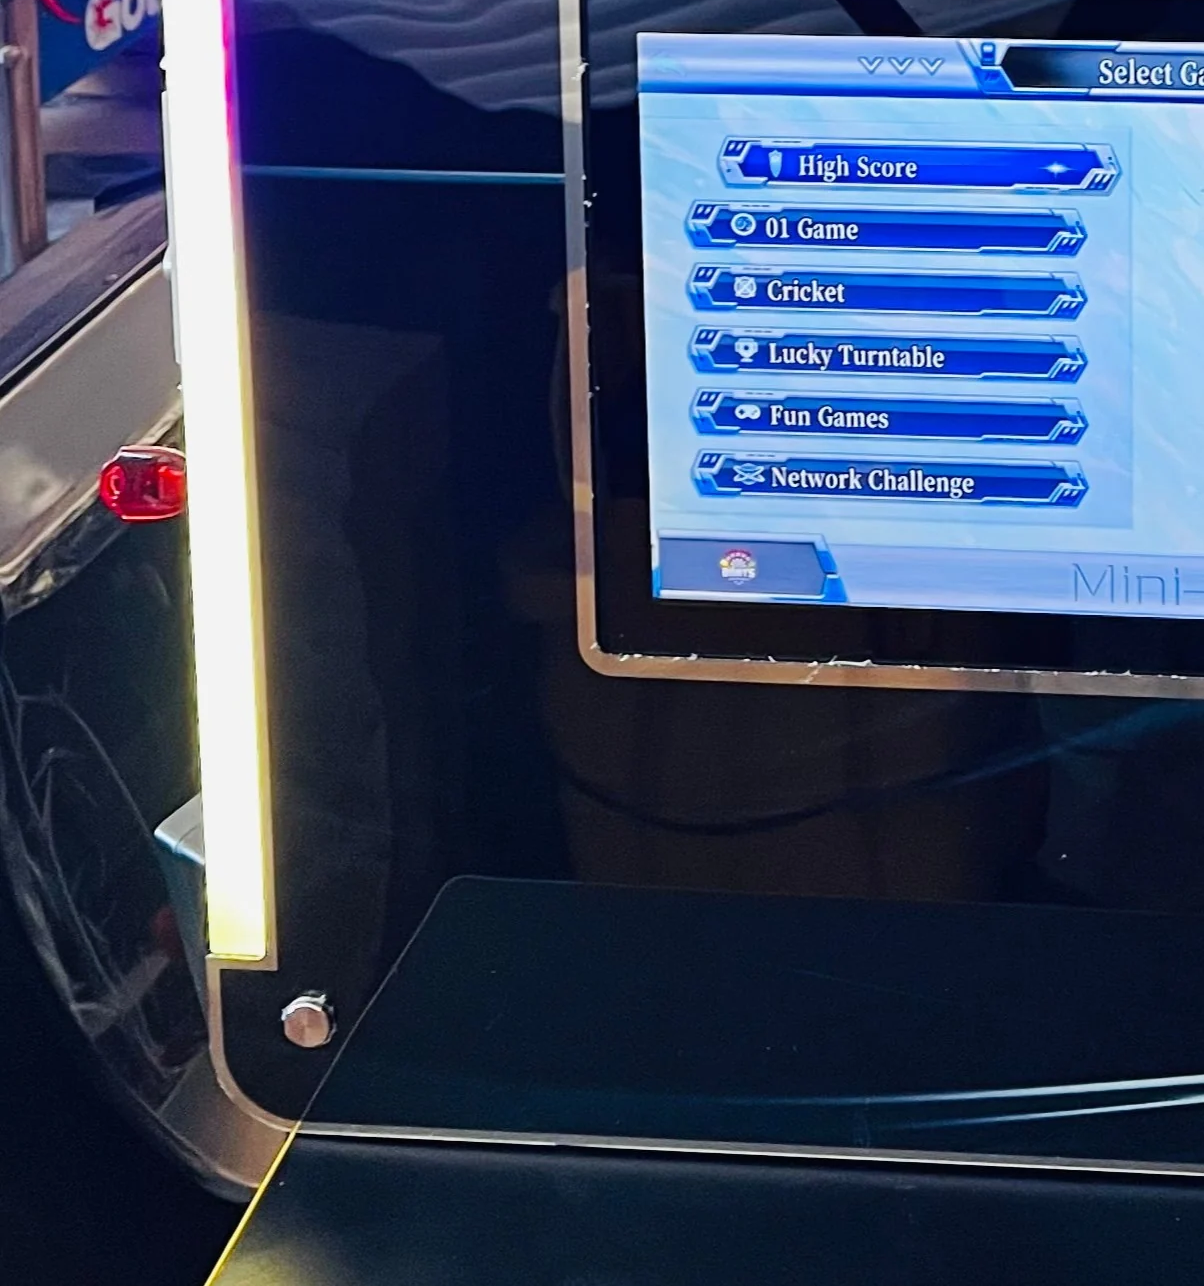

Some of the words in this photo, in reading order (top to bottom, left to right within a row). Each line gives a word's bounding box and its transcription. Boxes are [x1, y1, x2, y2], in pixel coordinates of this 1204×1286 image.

[1099, 59, 1172, 86] Select
[798, 154, 850, 183] High
[857, 156, 918, 179] Score
[765, 216, 790, 239] 01
[797, 217, 859, 241] Game
[766, 279, 845, 304] Cricket
[768, 343, 832, 370] Lucky
[837, 343, 945, 369] Turntable
[769, 405, 811, 427] Fun
[817, 406, 889, 430] Games
[771, 466, 862, 491] Network
[867, 468, 975, 499] Challenge
